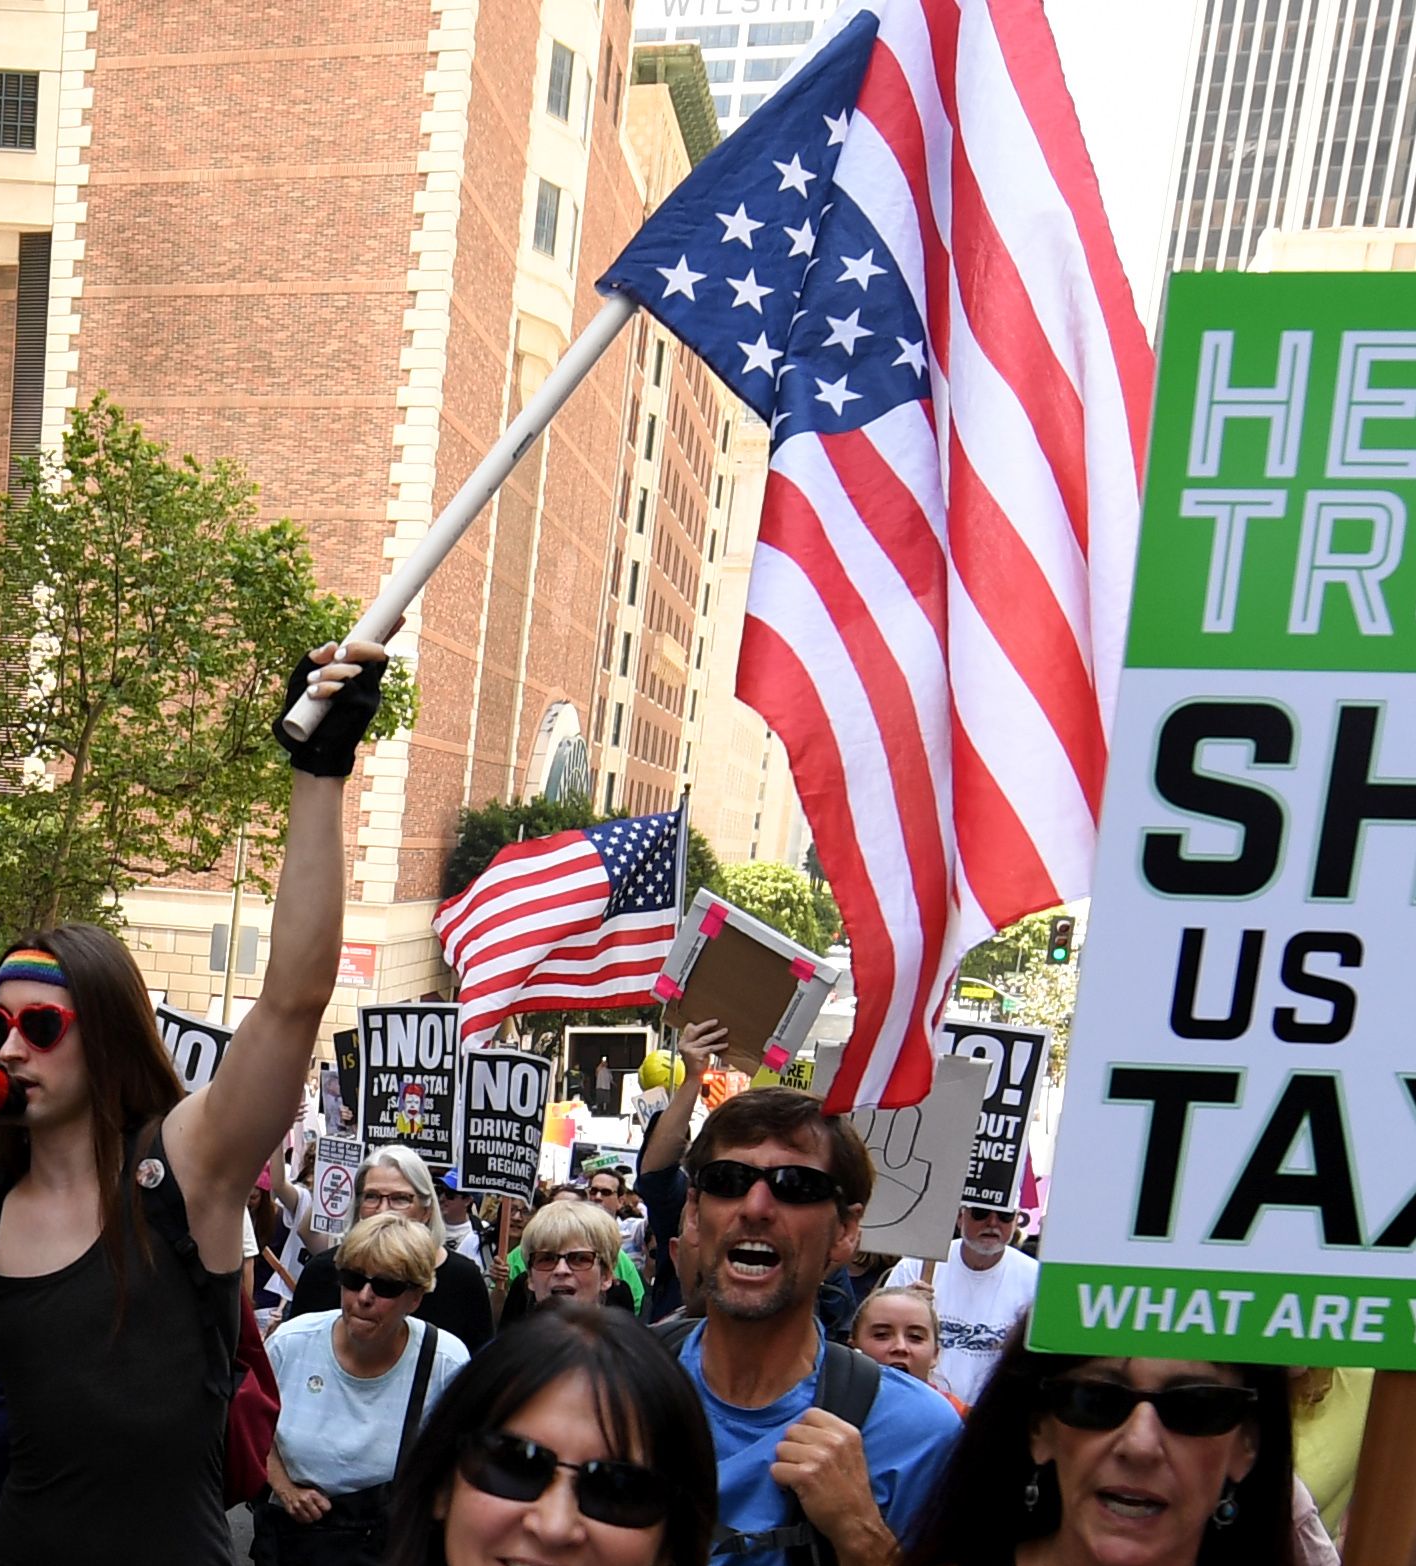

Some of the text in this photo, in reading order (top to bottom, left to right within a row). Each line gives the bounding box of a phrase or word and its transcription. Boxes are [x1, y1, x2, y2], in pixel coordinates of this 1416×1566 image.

[1168, 927, 1366, 1046] US
[470, 1060, 548, 1122] NO!
[469, 1117, 522, 1142] DRIVE
[1078, 1283, 1255, 1335] WHAT
[1262, 1294, 1392, 1343] ARE
